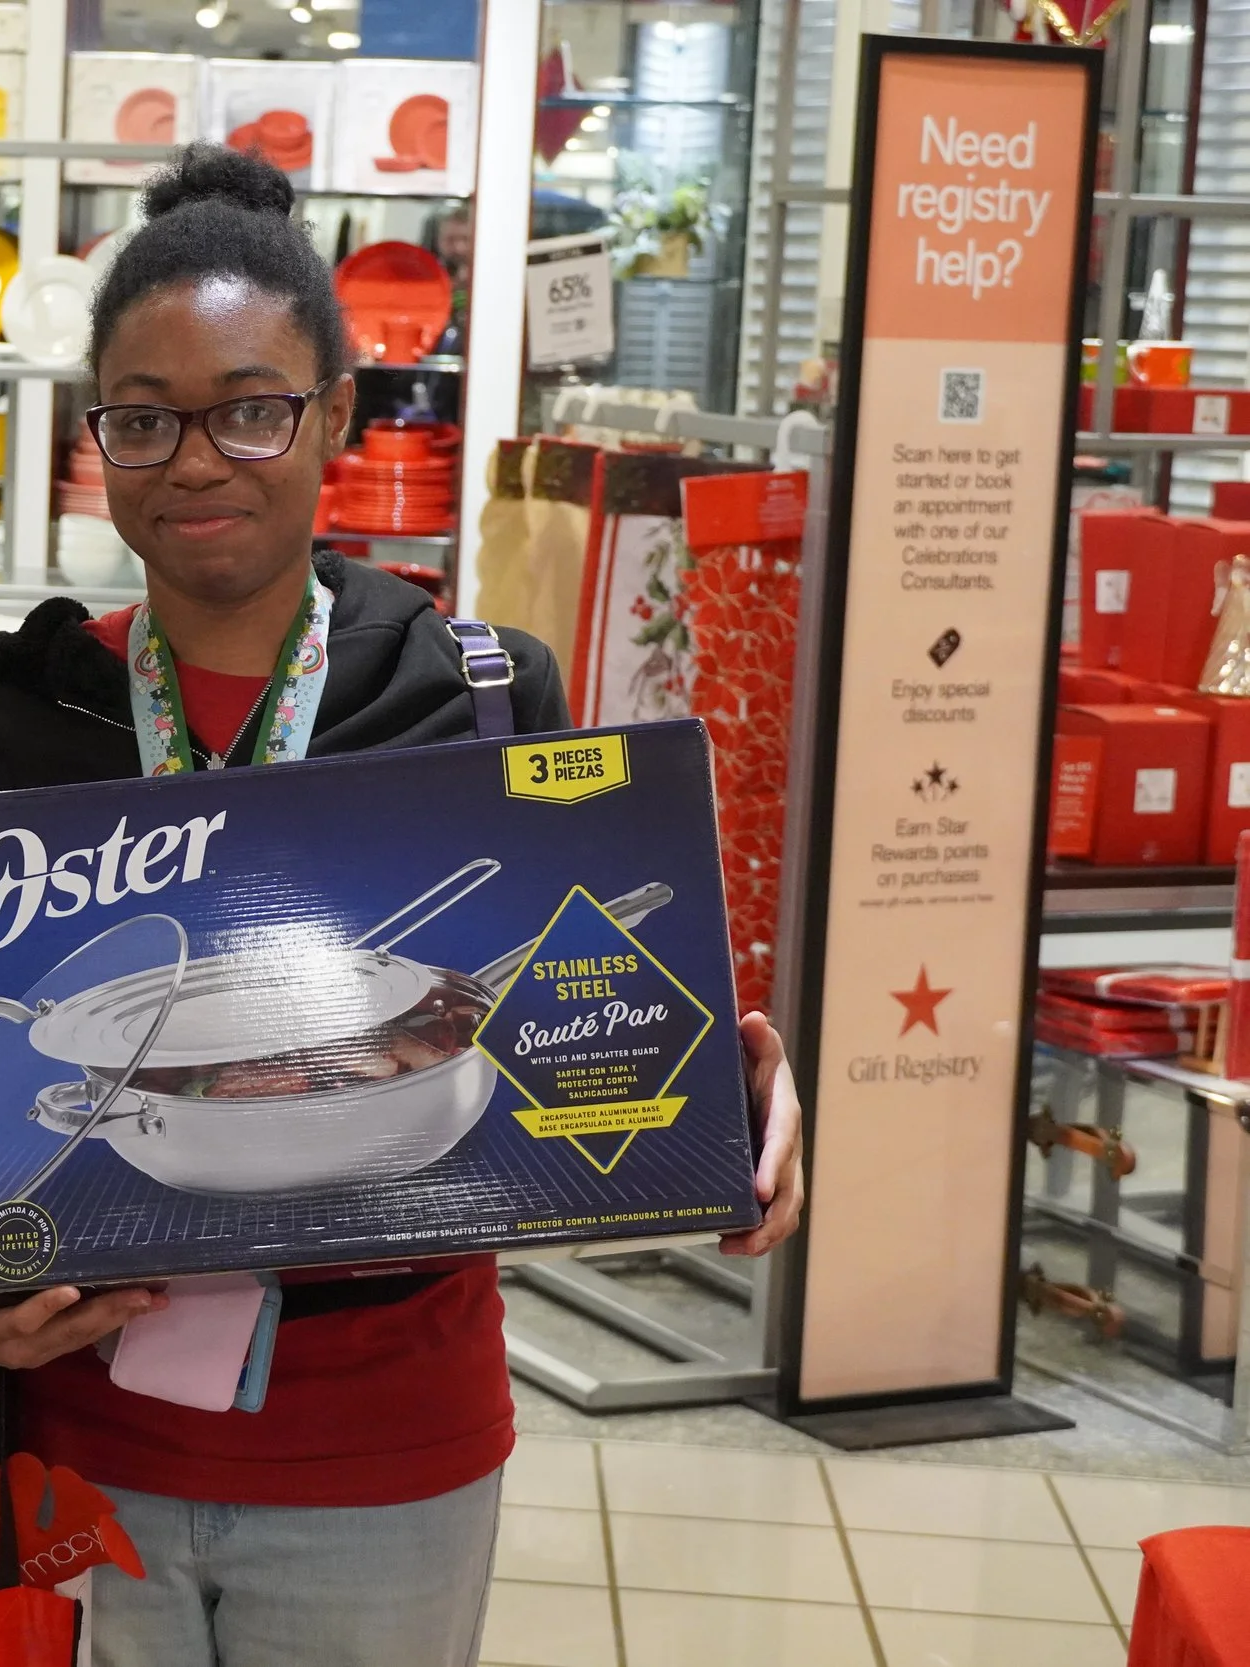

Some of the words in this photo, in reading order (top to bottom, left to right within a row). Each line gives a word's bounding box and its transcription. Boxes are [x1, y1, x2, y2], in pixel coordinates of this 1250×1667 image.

[920, 114, 1037, 169] Need
[897, 172, 1052, 237] registry
[916, 237, 1023, 300] help?
[548, 273, 593, 303] 65%
[892, 443, 933, 464] Scan
[937, 445, 972, 464] here
[977, 447, 992, 464] to
[995, 448, 1021, 469] get
[895, 473, 950, 489] started
[953, 475, 971, 489] or
[975, 472, 1012, 489] book
[893, 500, 912, 514] an
[917, 497, 1013, 518] appointment
[894, 521, 925, 539] with
[929, 525, 959, 540] one
[963, 521, 980, 540] of
[983, 525, 1009, 540] our
[901, 544, 999, 565] Celebrations
[900, 570, 995, 590] Consultants.
[891, 679, 934, 701] Enjoy
[938, 682, 990, 700] special
[902, 705, 976, 724] discounts
[528, 753, 549, 784] 3
[553, 747, 603, 765] PIECES
[554, 763, 605, 782] PIEZAS
[895, 817, 931, 837] Earn
[937, 816, 969, 836] Star
[870, 843, 938, 863] Rewards
[943, 843, 990, 863] points
[876, 872, 897, 888] on
[900, 868, 980, 889] purchases
[532, 954, 638, 981] STAINLESS
[556, 979, 616, 1001] STEEL
[514, 1011, 599, 1056] Sauté
[602, 1000, 668, 1037] Pan
[530, 1055, 551, 1065] WITH
[555, 1054, 568, 1064] LID
[571, 1052, 587, 1062] AND
[590, 1049, 629, 1060] SPLATTER
[632, 1046, 660, 1056] GUARD
[589, 1066, 606, 1076] CON
[609, 1065, 629, 1075] TAPA
[632, 1064, 637, 1073] Y
[893, 1052, 985, 1087] Registry
[557, 1078, 603, 1090] PROTECTOR
[606, 1075, 638, 1085] CONTRA
[568, 1087, 629, 1099] SALPICADURAS
[539, 1123, 557, 1132] BASE
[560, 1119, 613, 1130] ENCAPSULADA
[615, 1117, 625, 1126] DE
[628, 1115, 664, 1125] ALUMINIO
[540, 1110, 597, 1123] ENCAPSULATED
[599, 1107, 639, 1117] ALUMINUM
[642, 1105, 660, 1114] BASE
[28, 1209, 39, 1220] DE
[517, 1218, 563, 1230] PROTECTOR
[566, 1216, 597, 1227] CONTRA
[600, 1211, 660, 1223] SALPICADURAS
[663, 1209, 674, 1218] DE
[677, 1207, 703, 1217] MICRO
[706, 1205, 733, 1214] MALLA
[37, 1218, 49, 1233] POR
[440, 1226, 478, 1238] SPLATTER
[481, 1223, 508, 1234] GUARD
[42, 1234, 51, 1253] VIDA
